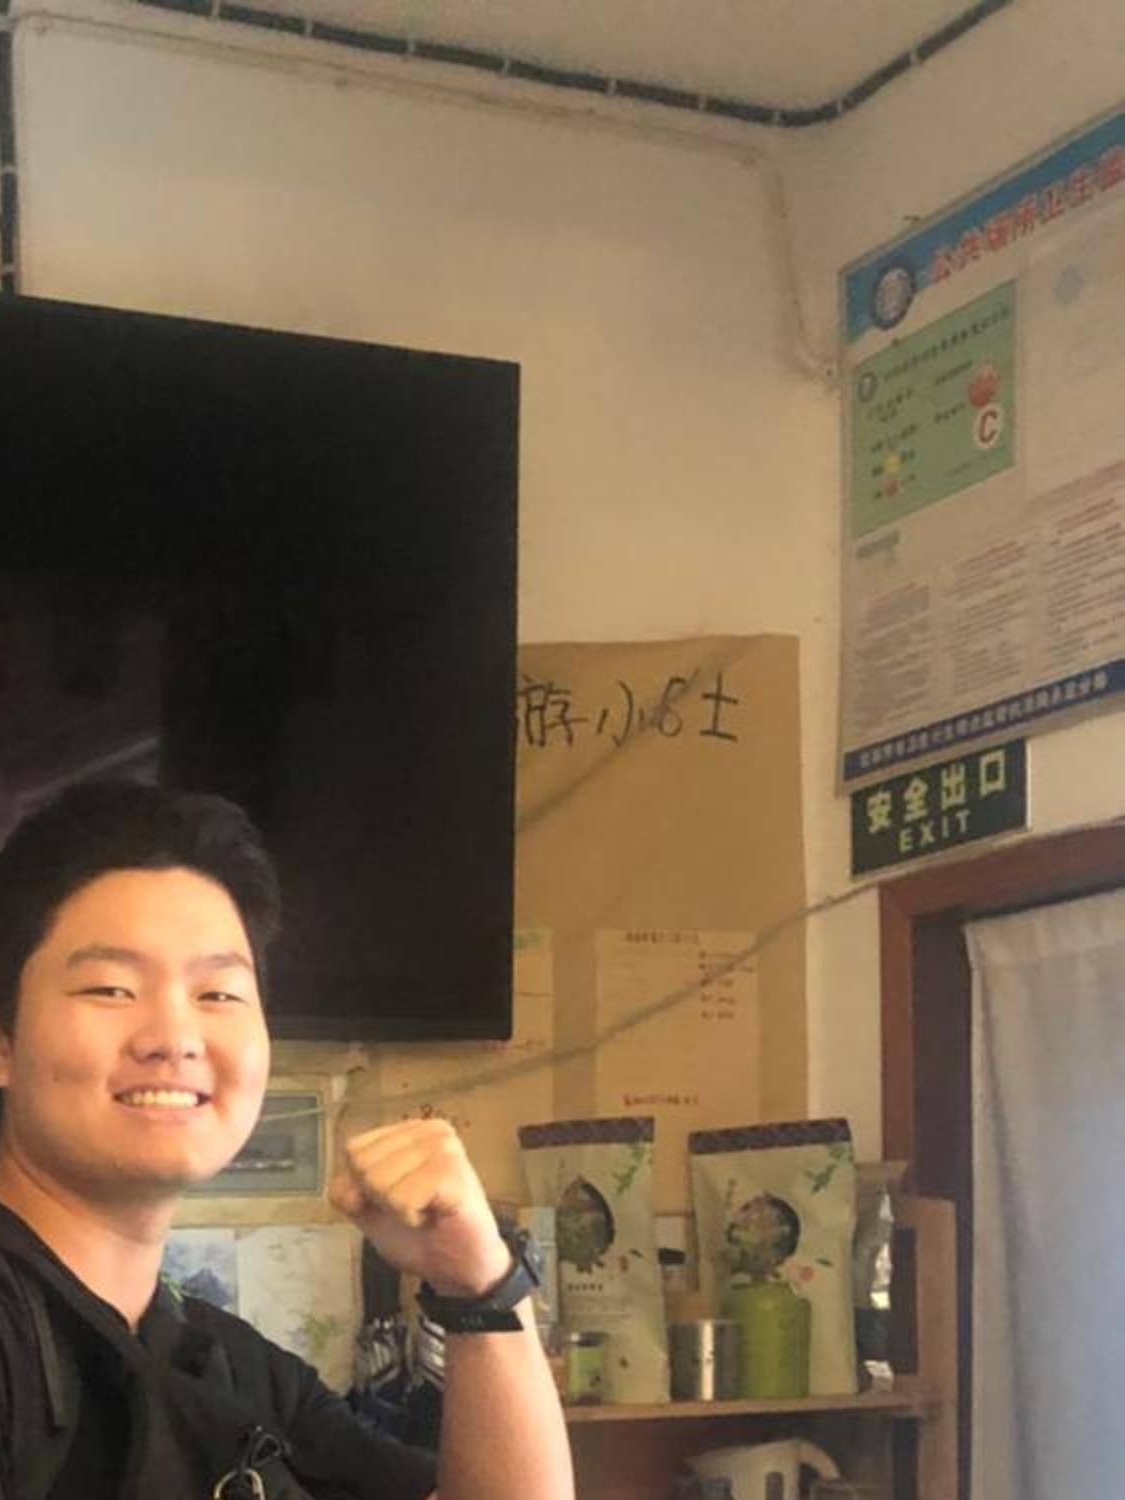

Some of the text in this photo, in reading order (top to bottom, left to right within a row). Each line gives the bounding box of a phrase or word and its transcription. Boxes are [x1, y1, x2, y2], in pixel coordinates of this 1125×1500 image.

[866, 749, 1006, 834] 安全出口
[899, 808, 971, 853] EXIT
